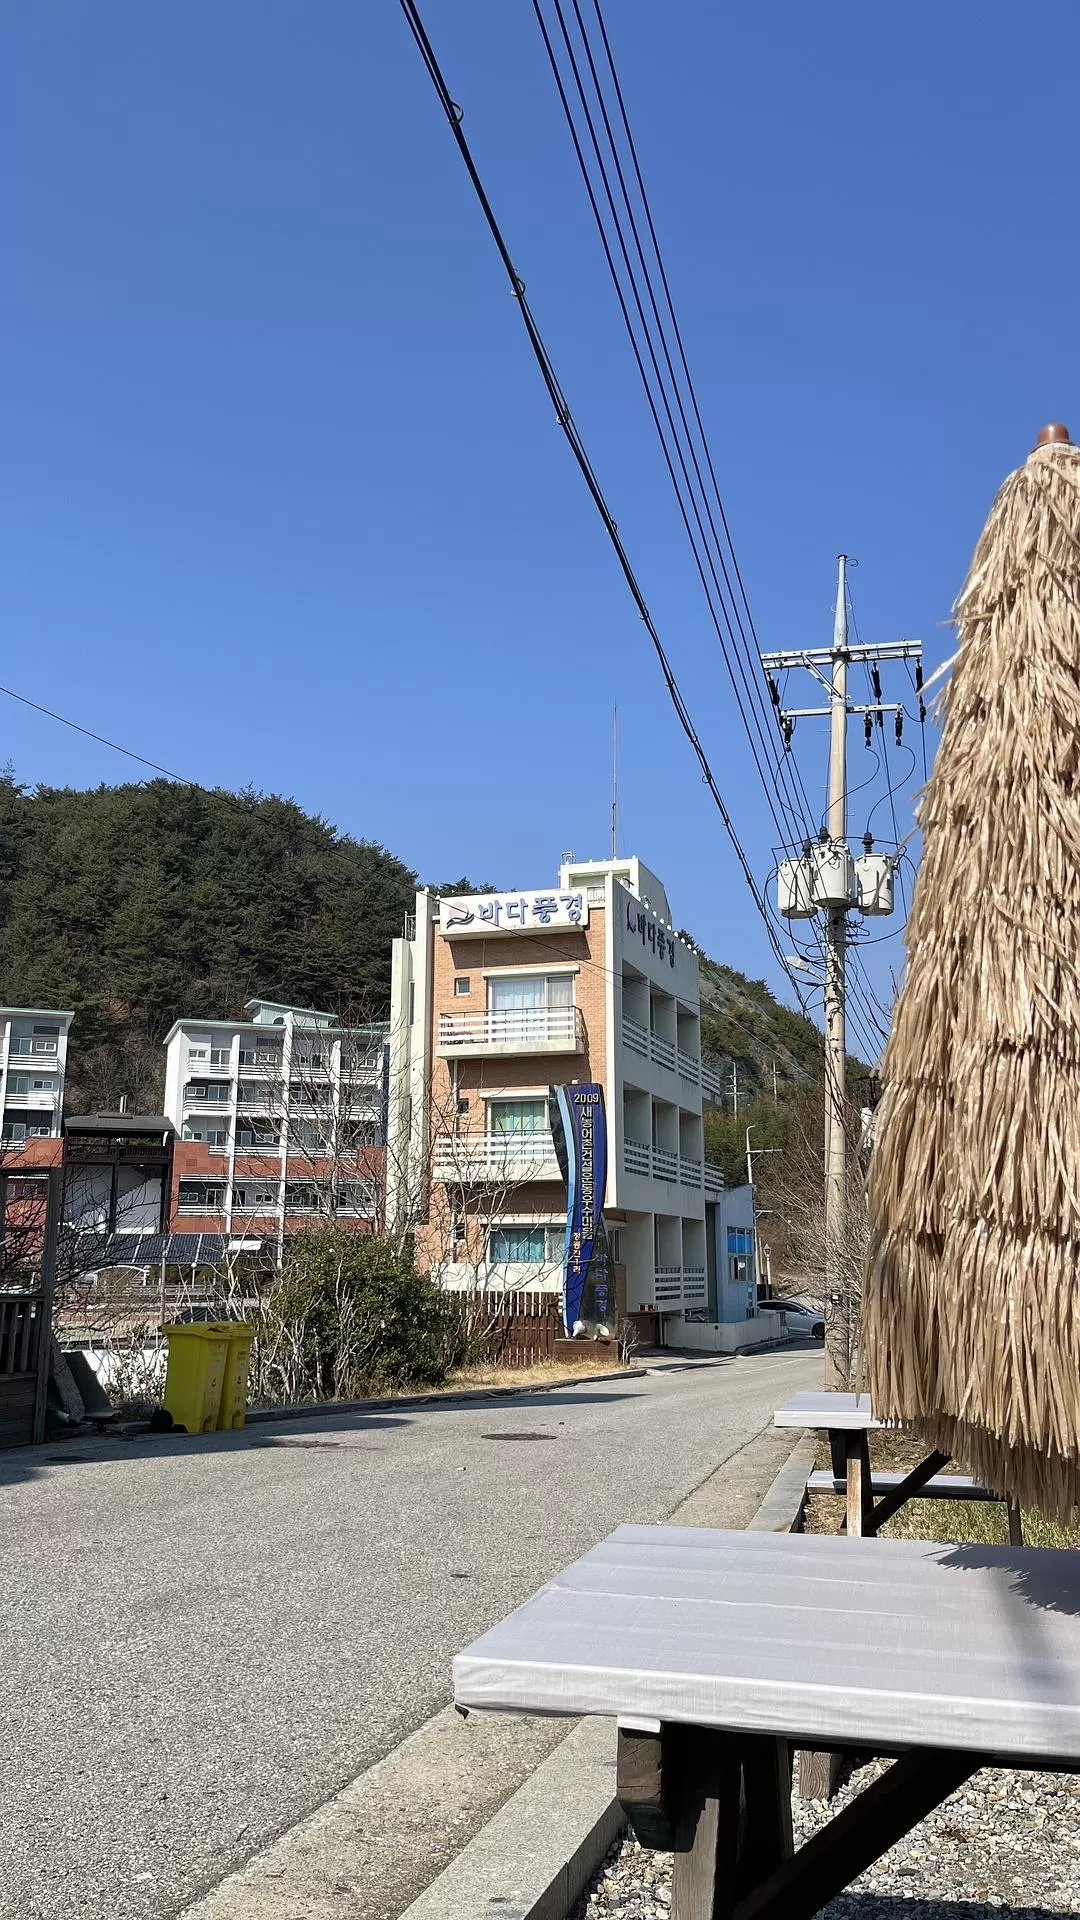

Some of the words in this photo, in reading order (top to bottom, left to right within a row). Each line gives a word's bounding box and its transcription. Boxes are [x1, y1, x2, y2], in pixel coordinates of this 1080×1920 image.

[477, 893, 584, 926] 바다풍경
[636, 912, 675, 969] 바다풍경
[574, 1093, 599, 1104] 2009
